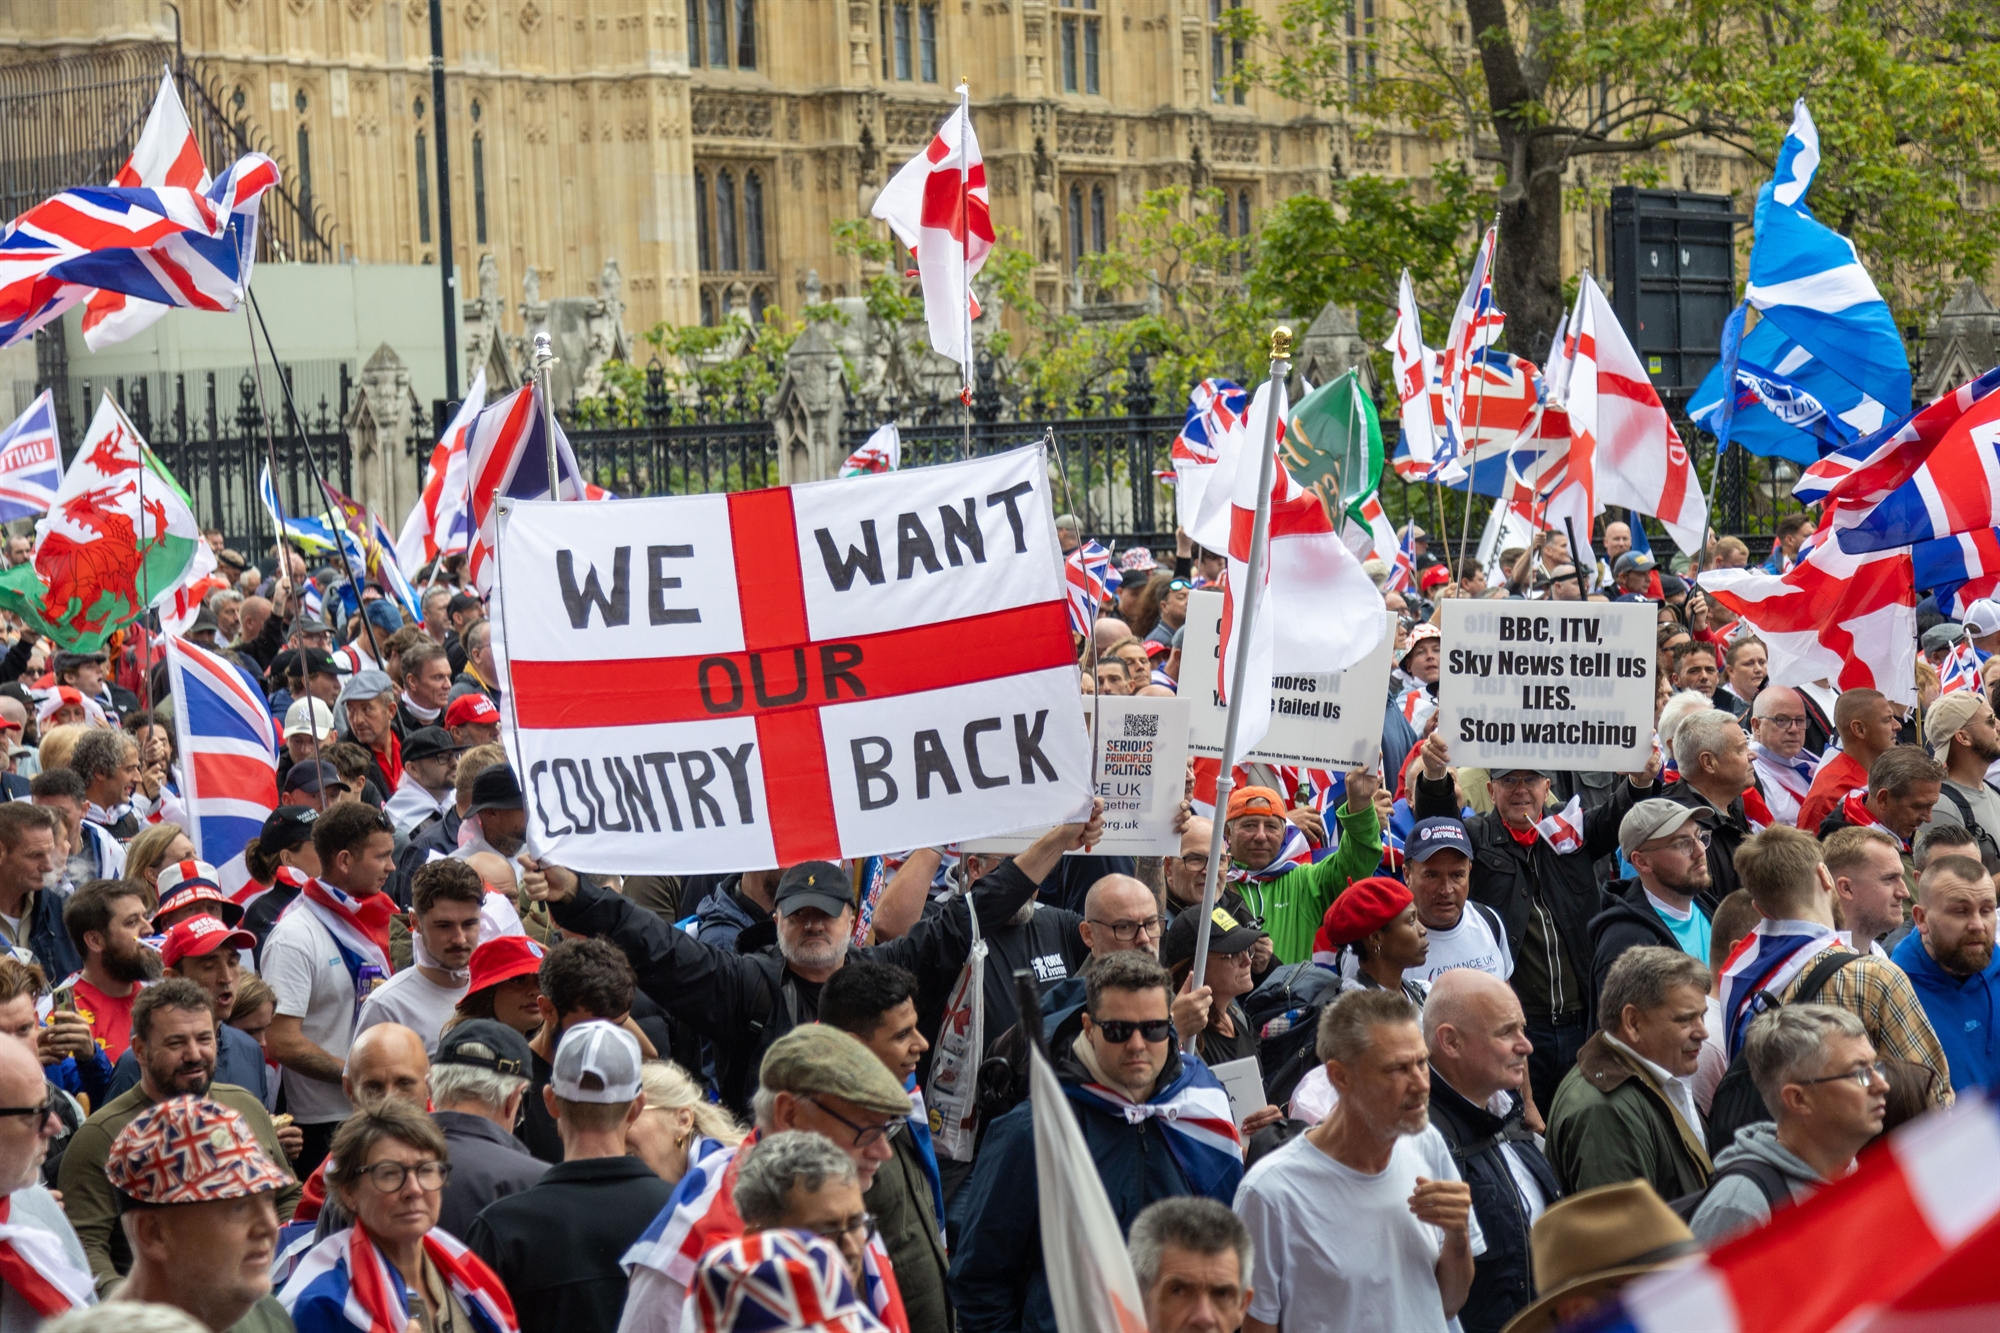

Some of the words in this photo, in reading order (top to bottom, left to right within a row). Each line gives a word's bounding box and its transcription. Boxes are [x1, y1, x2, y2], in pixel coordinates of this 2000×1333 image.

[1774, 398, 1817, 419] CLUB
[556, 544, 701, 629] WE
[814, 481, 1033, 591] WANT
[1500, 616, 1554, 644] BBC,
[1560, 617, 1603, 645] ITV,
[1449, 650, 1493, 677] Sky
[1498, 651, 1564, 676] News
[1570, 653, 1610, 677] tell
[1617, 657, 1646, 678] us
[699, 644, 867, 714] OUR
[1278, 697, 1320, 717] failed
[1323, 702, 1341, 719] Us
[1522, 686, 1576, 710] LIES.
[1460, 718, 1515, 745] Stop
[1521, 721, 1636, 749] watching
[1105, 753, 1153, 763] PRINCIPLED
[1106, 740, 1153, 753] SERIOUS
[530, 742, 755, 838] COUNTRY
[850, 710, 1059, 811] BACK
[1104, 764, 1152, 776] POLITICS
[1117, 783, 1141, 796] UK
[1104, 800, 1141, 811] gether
